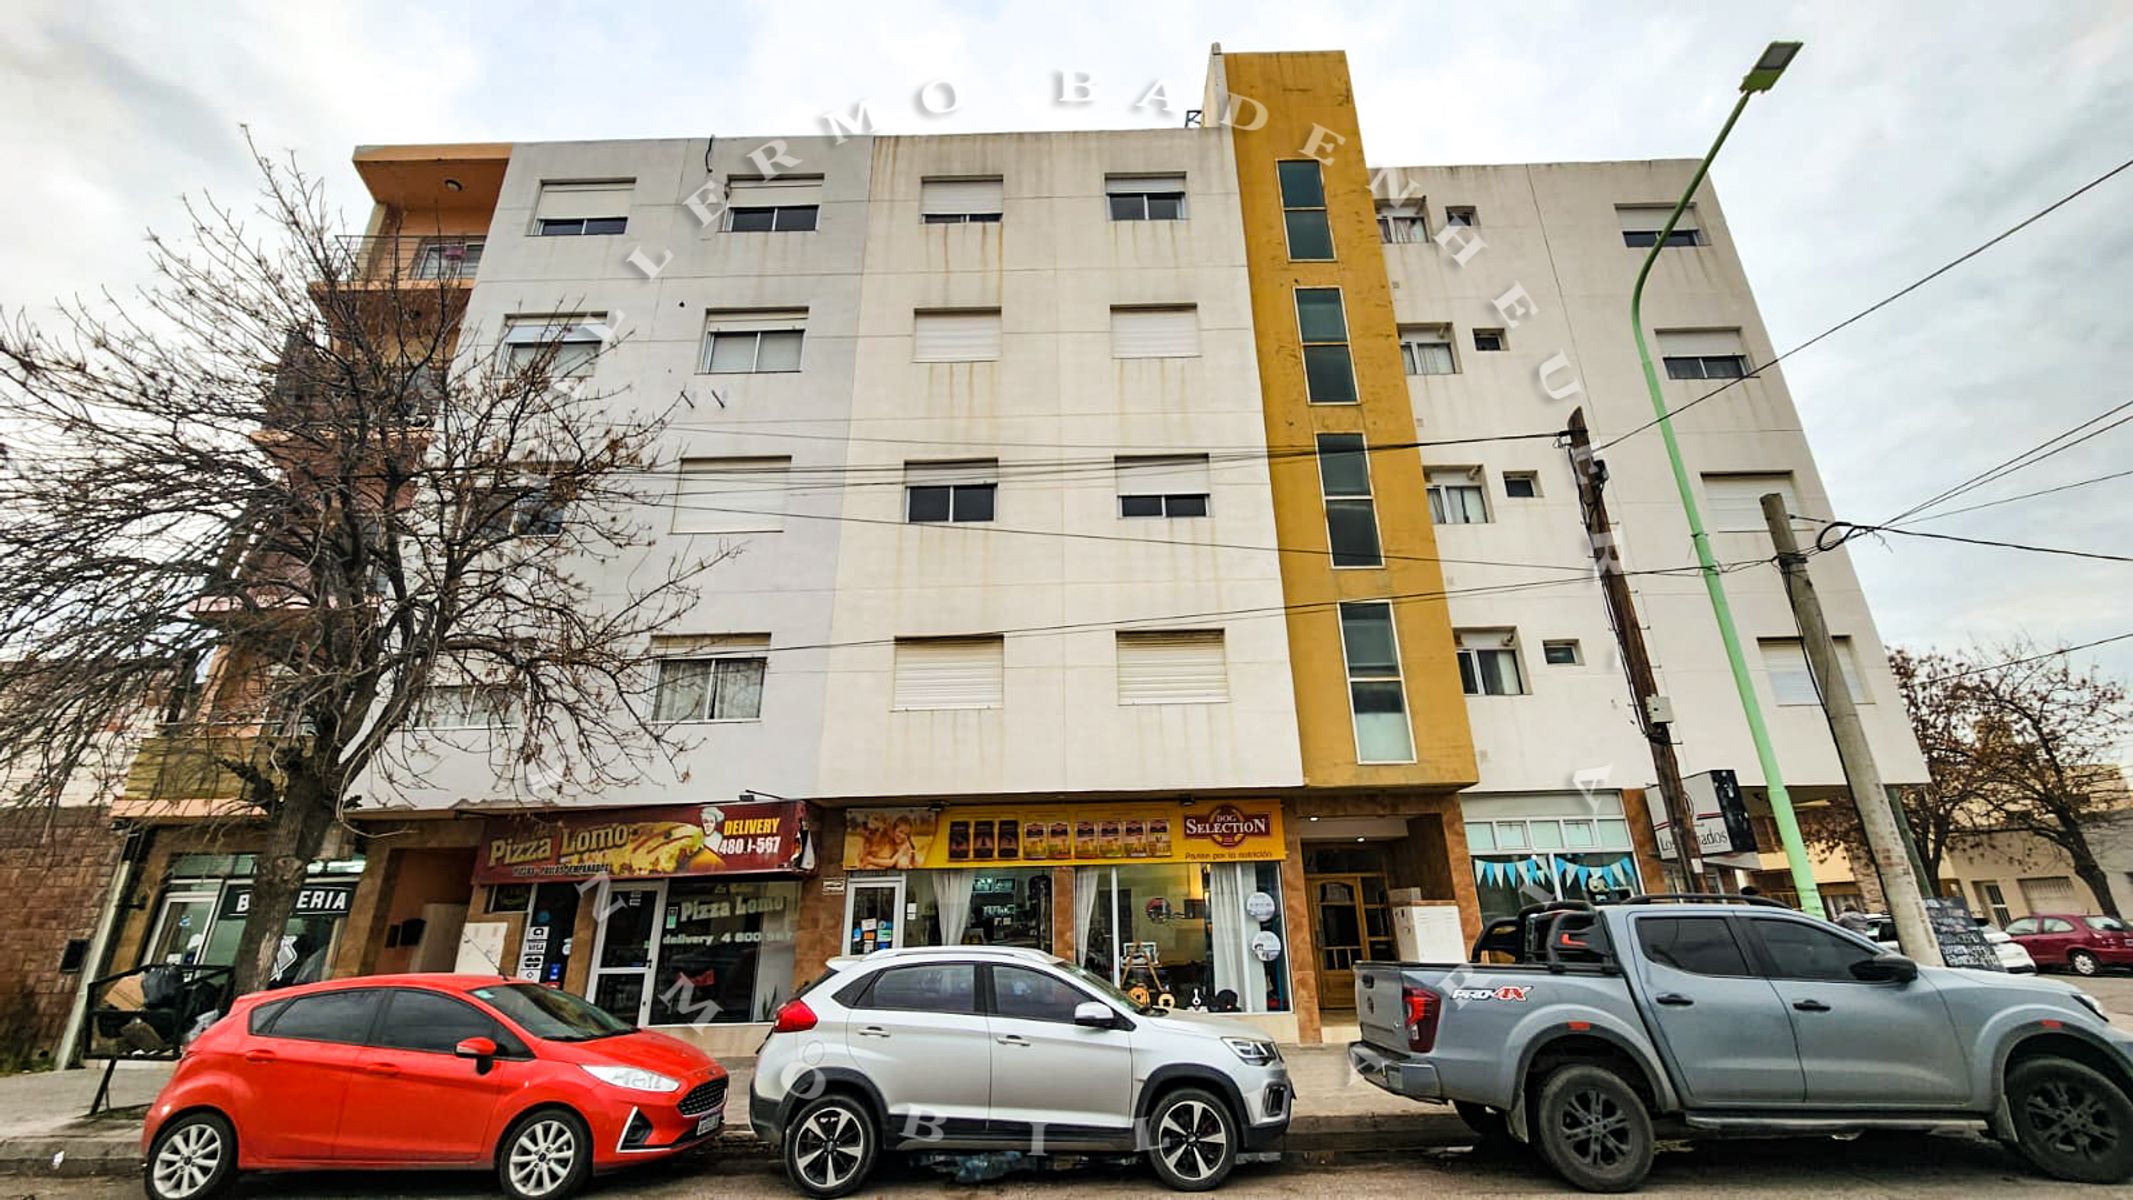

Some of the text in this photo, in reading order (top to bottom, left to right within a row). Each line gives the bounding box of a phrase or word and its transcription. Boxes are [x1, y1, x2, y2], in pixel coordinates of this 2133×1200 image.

[723, 817, 780, 836] DELIVERY
[1185, 818, 1266, 834] SELECTION
[1216, 814, 1237, 823] DOG
[488, 836, 553, 867] Pizza
[560, 822, 630, 854] Lomo
[236, 890, 347, 912] BERIA
[680, 895, 785, 922] Pizza Lomo
[662, 933, 715, 946] delivery
